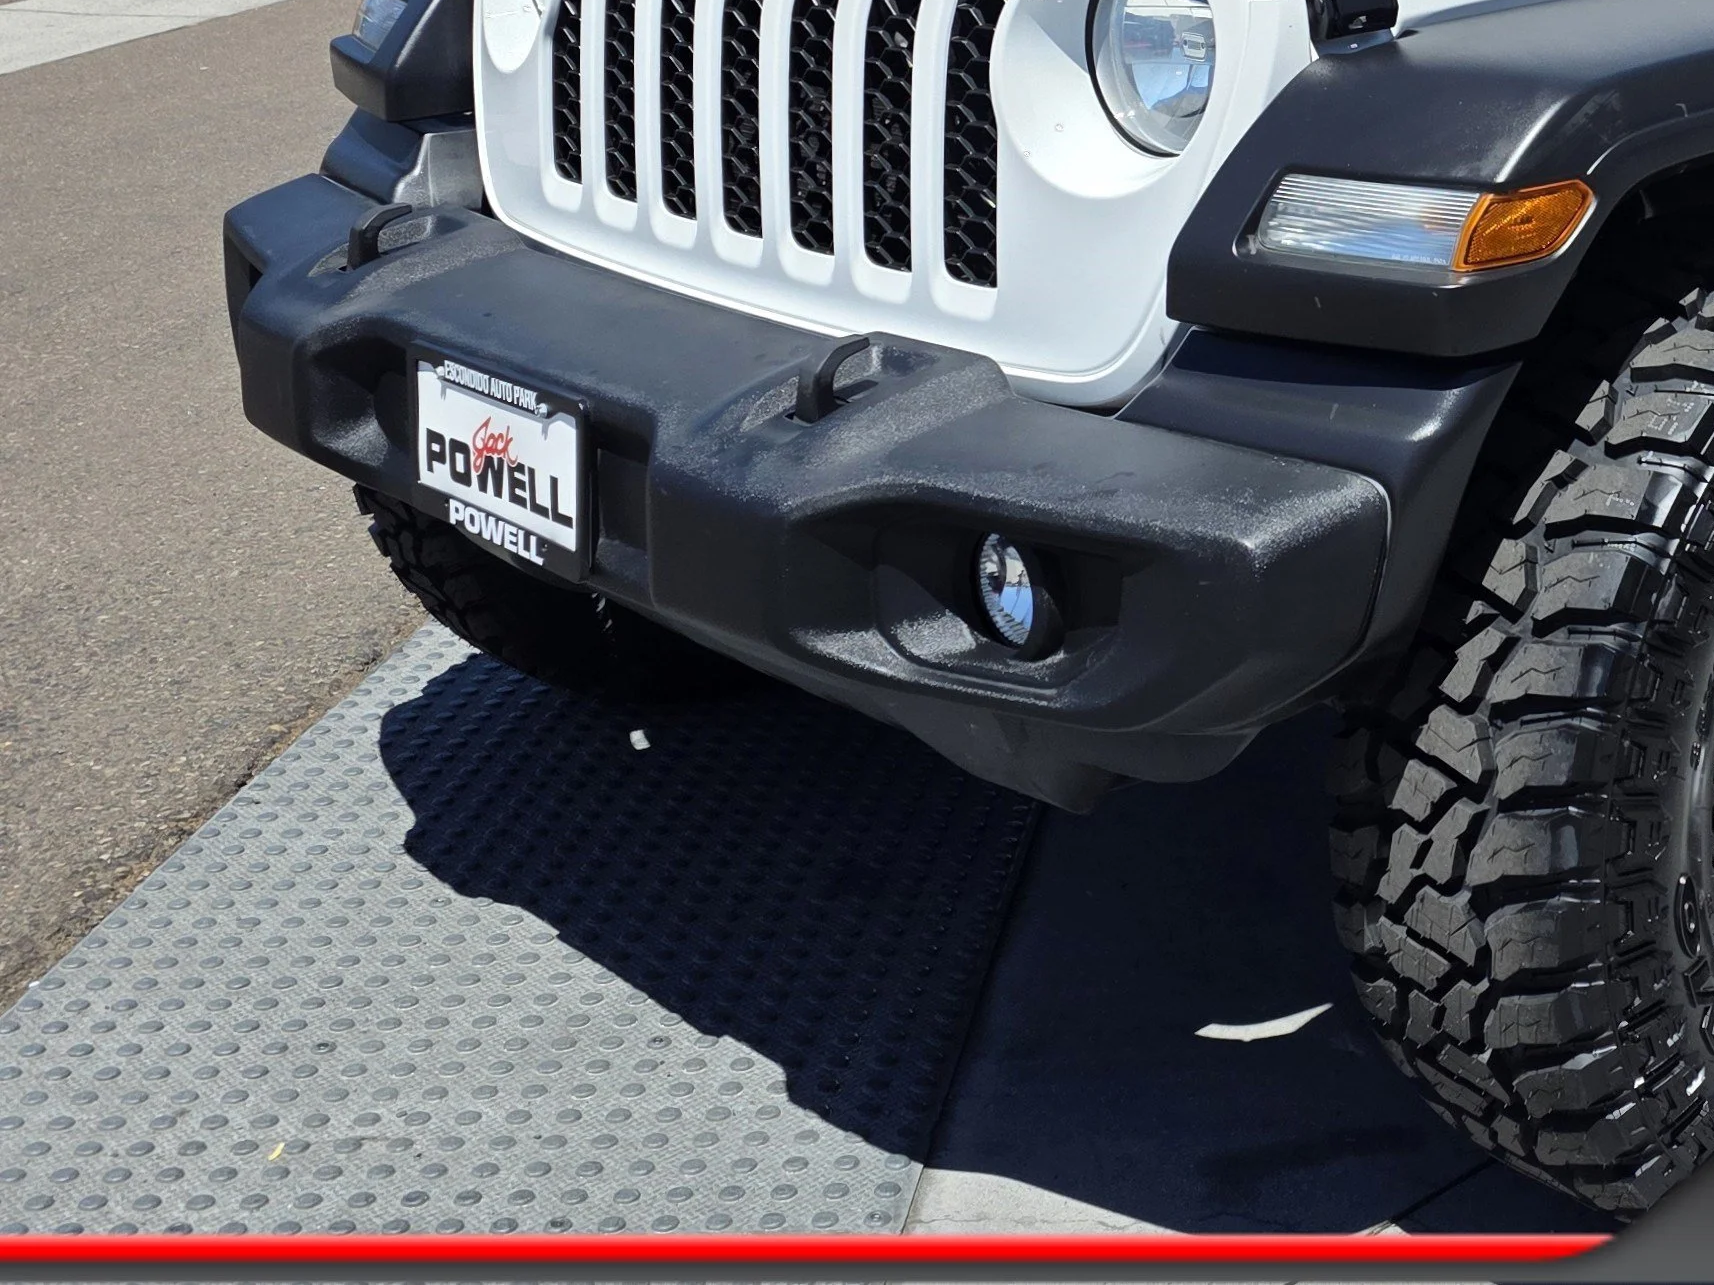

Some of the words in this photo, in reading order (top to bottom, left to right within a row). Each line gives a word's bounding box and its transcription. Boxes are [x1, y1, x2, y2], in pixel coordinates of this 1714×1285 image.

[444, 360, 490, 394] ESCONDIDO
[490, 377, 513, 403] AUTO
[513, 386, 538, 410] PARK
[472, 416, 519, 475] Jack
[426, 427, 574, 530] POWELL
[449, 498, 545, 566] POWELL
